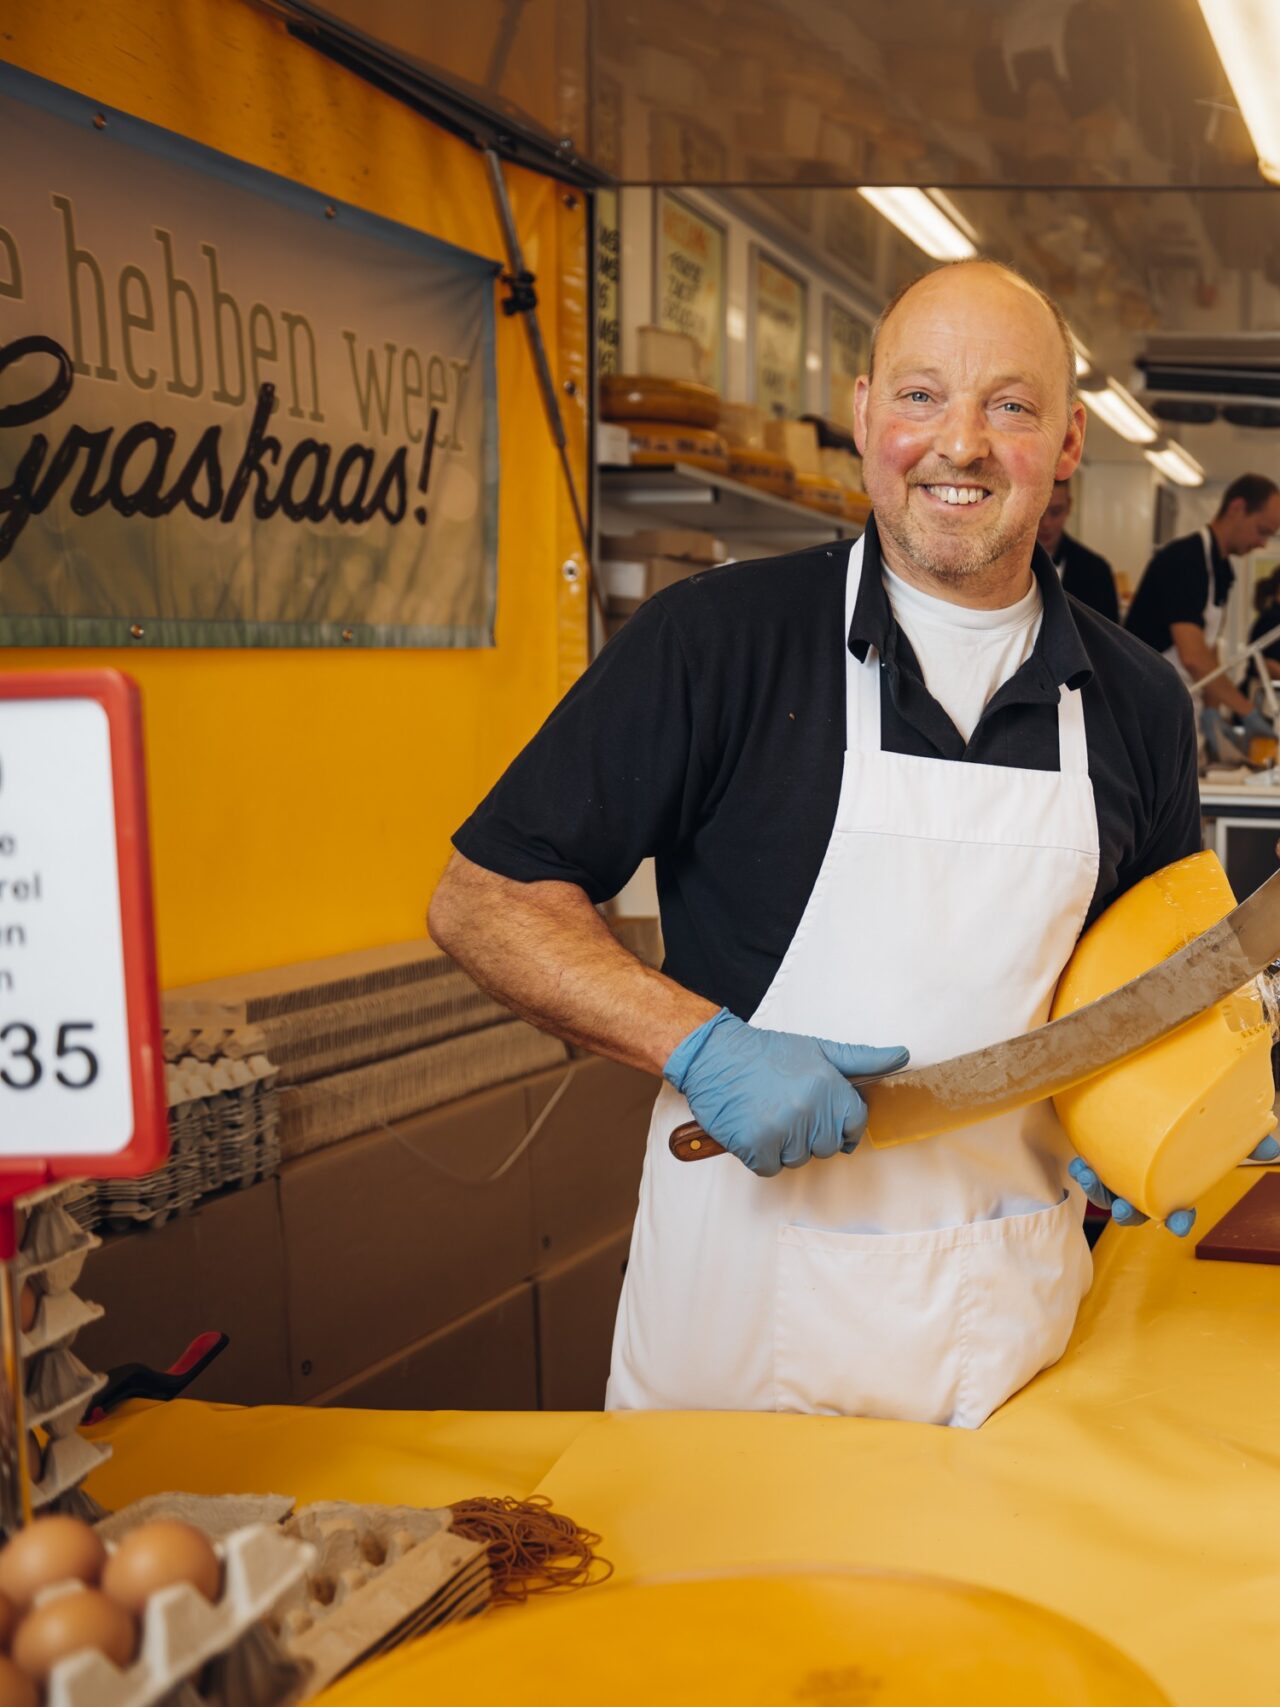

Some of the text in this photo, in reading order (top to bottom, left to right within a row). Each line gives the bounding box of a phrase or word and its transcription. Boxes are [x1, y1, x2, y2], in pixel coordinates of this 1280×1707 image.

[51, 194, 326, 423] hebben
[342, 329, 469, 452] weer
[0, 1021, 100, 1091] 35
